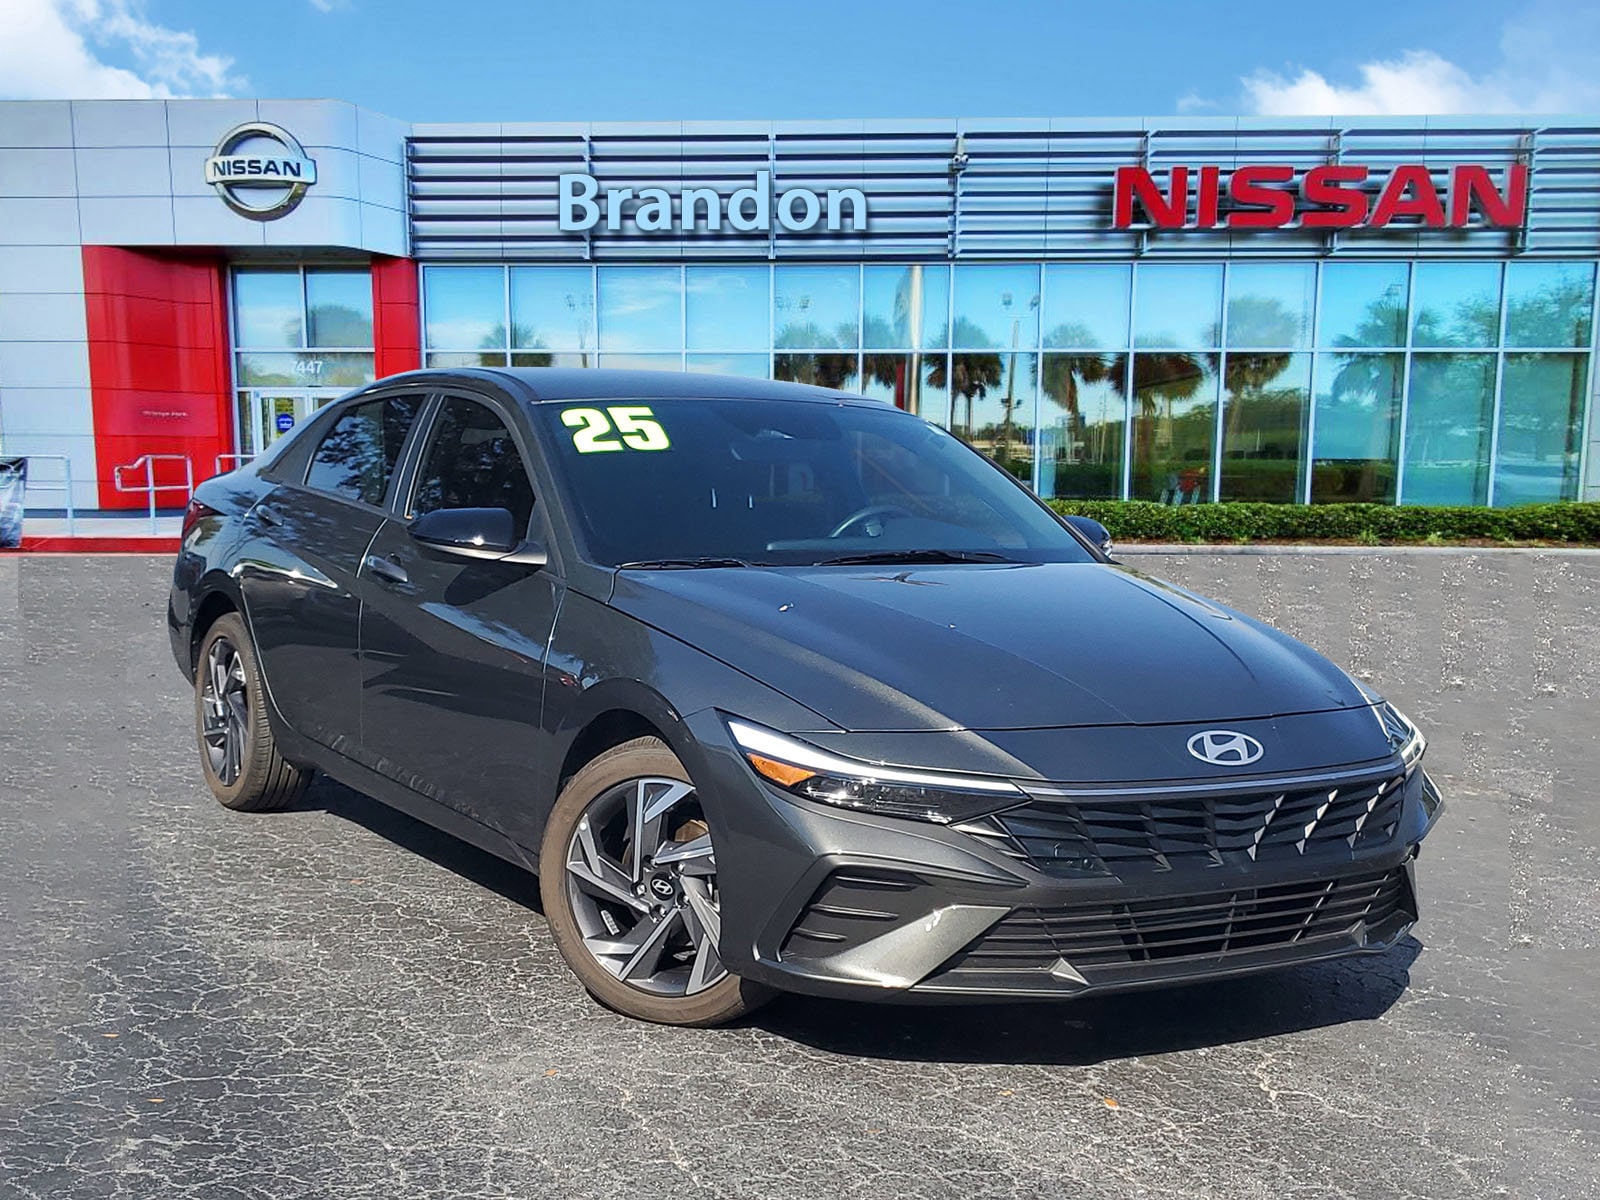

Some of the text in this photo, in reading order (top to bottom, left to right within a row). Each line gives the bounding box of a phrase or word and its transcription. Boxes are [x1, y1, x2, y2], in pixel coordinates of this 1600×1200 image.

[213, 160, 301, 177] NISSAN
[559, 170, 868, 231] Brandon
[1113, 165, 1528, 229] NISSAN
[560, 405, 672, 455] 25
